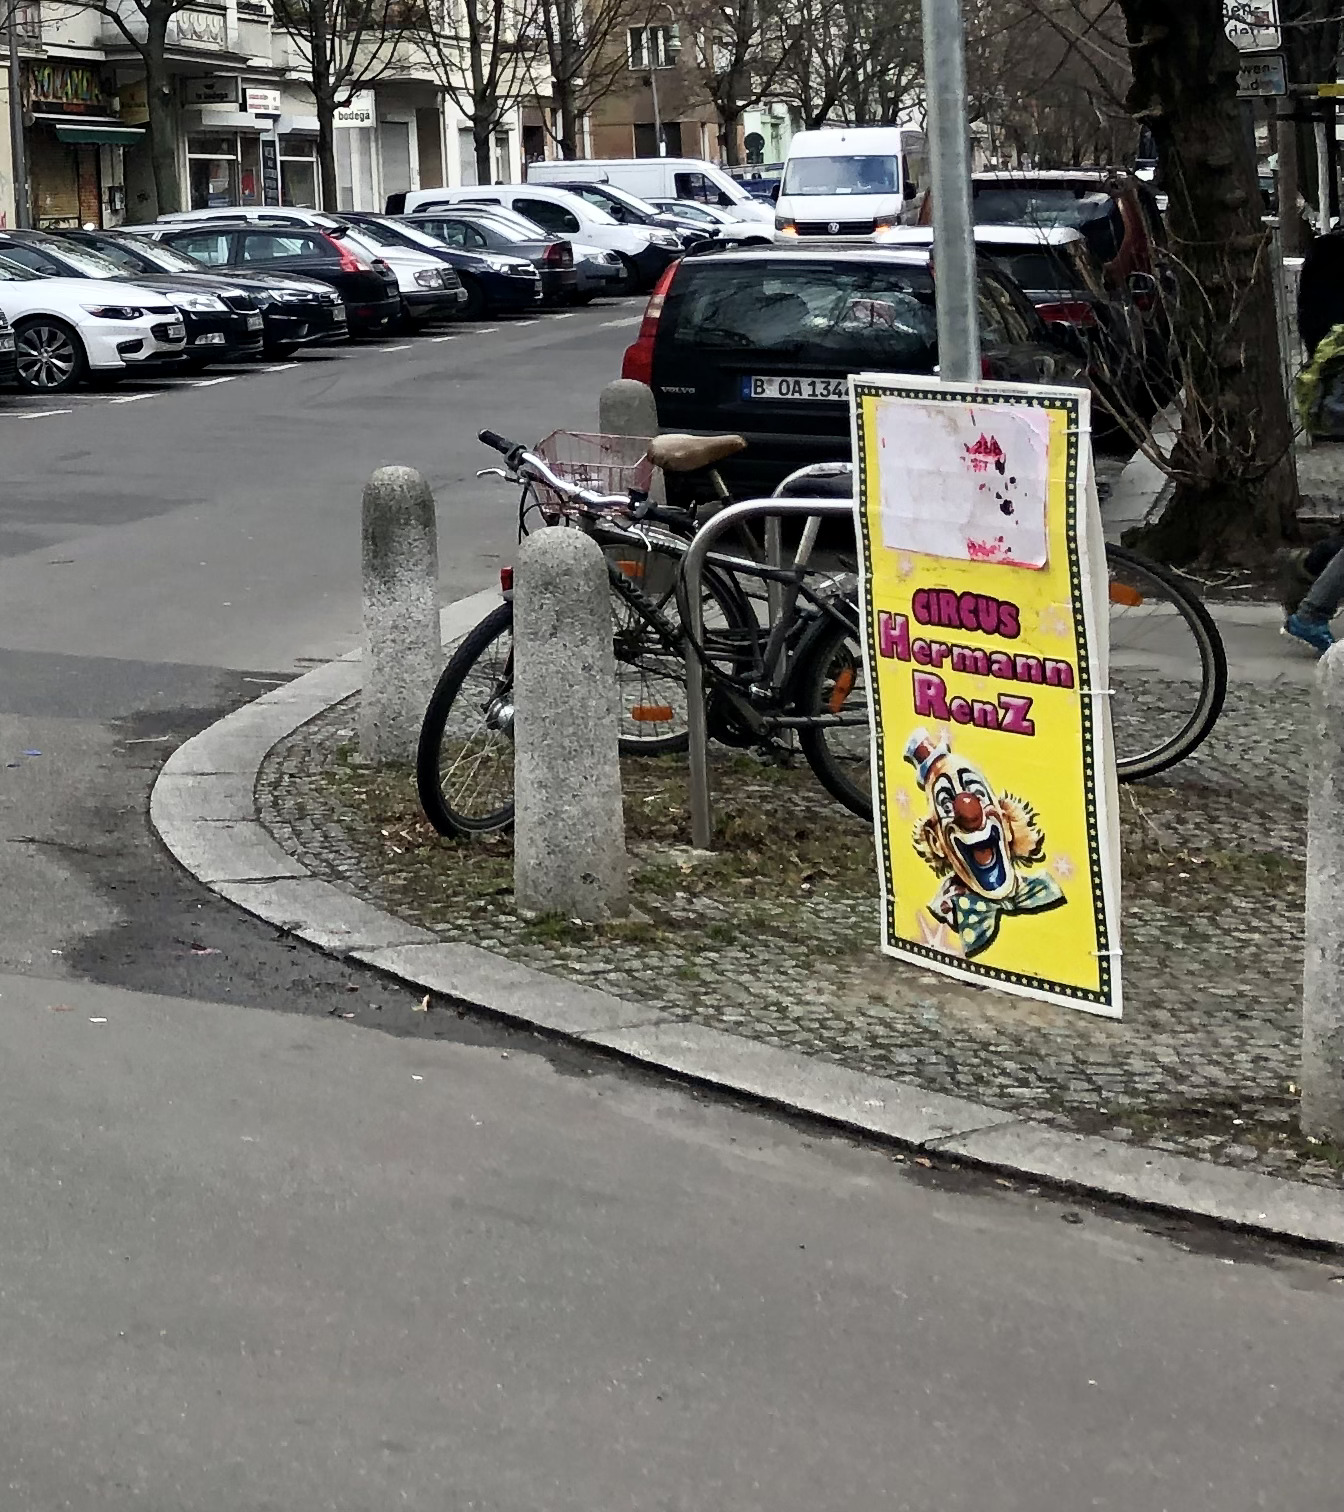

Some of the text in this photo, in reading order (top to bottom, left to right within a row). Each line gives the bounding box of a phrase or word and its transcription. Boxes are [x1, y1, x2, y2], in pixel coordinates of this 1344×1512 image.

[338, 110, 370, 122] bodega
[753, 378, 766, 396] B
[778, 379, 803, 397] OA
[912, 588, 1020, 639] CIRCUS
[878, 610, 1075, 689] Hermann
